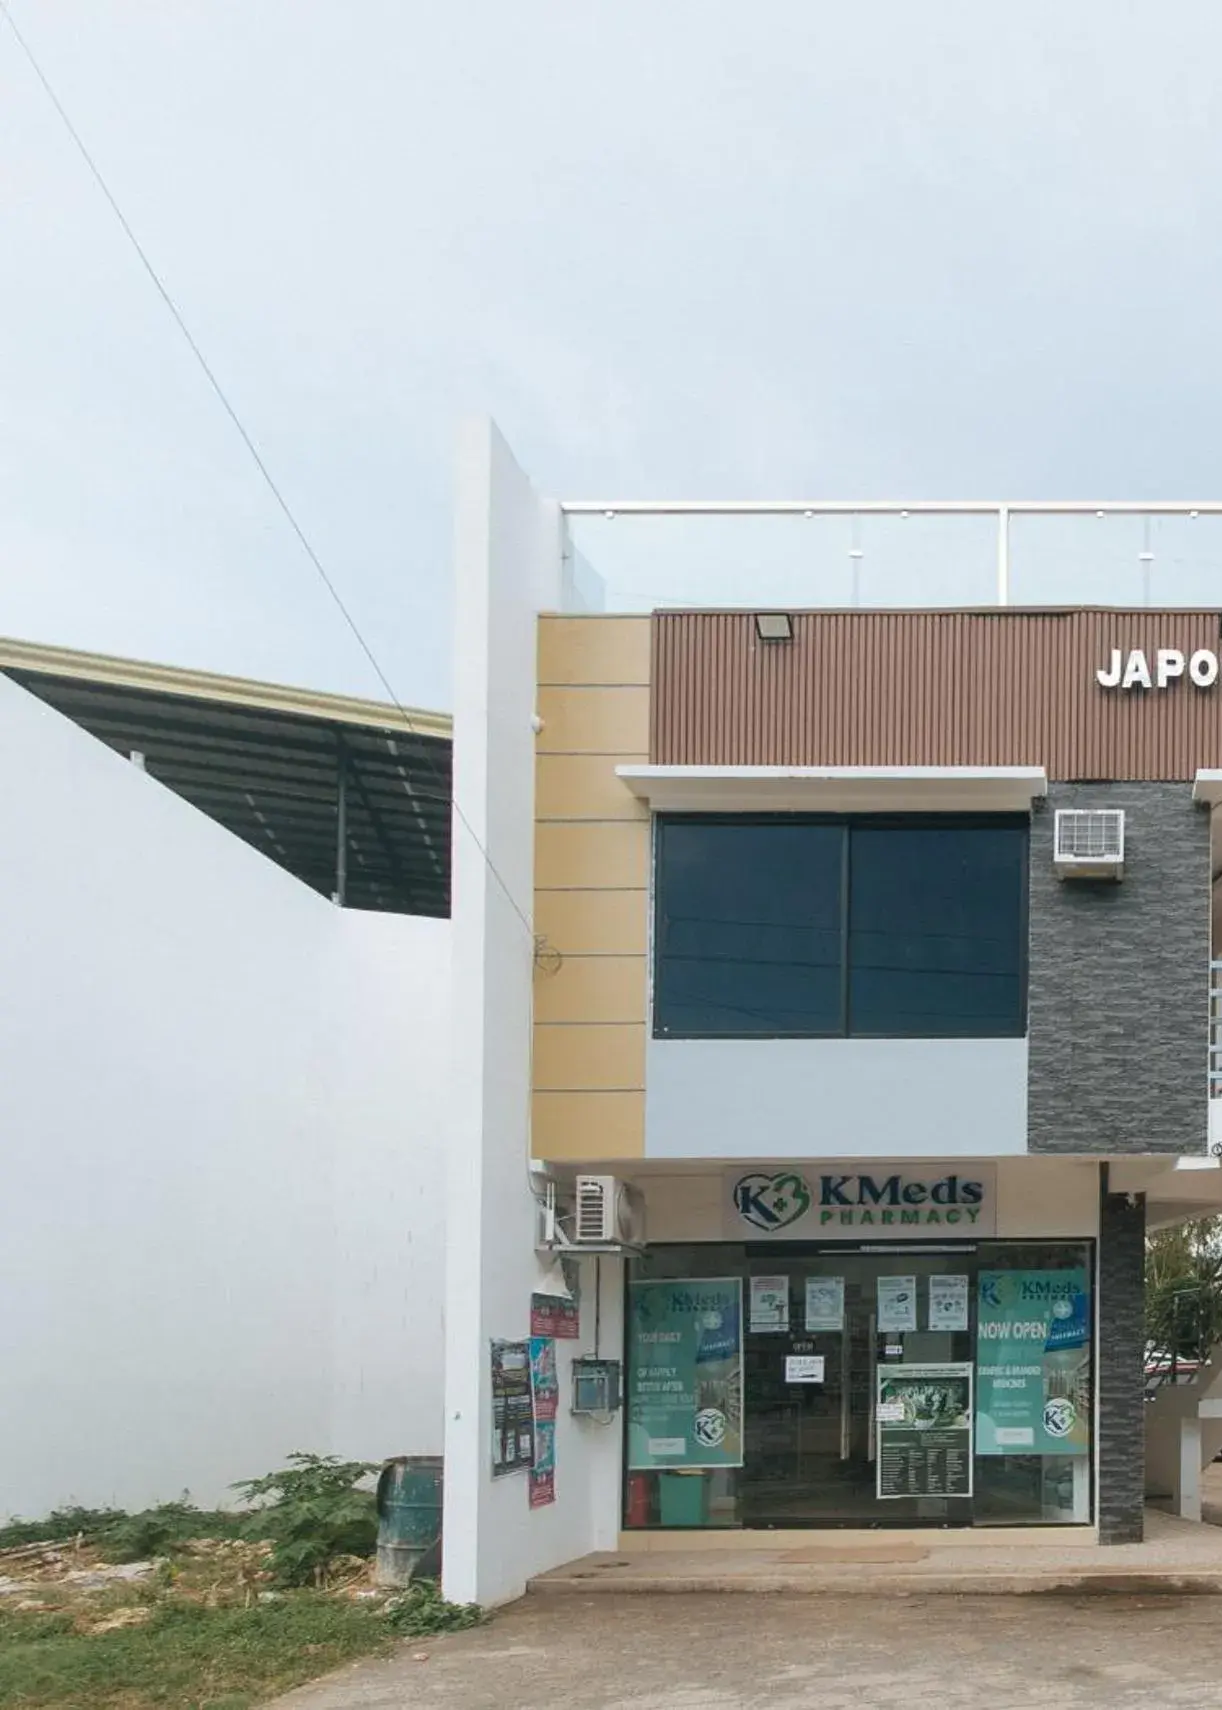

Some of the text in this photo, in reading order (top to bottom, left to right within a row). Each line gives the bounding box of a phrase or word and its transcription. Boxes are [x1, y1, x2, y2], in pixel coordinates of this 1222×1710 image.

[820, 1174, 984, 1206] KMeds
[820, 1208, 982, 1226] PHARMACY
[978, 1321, 1047, 1340] NOW OPEN
